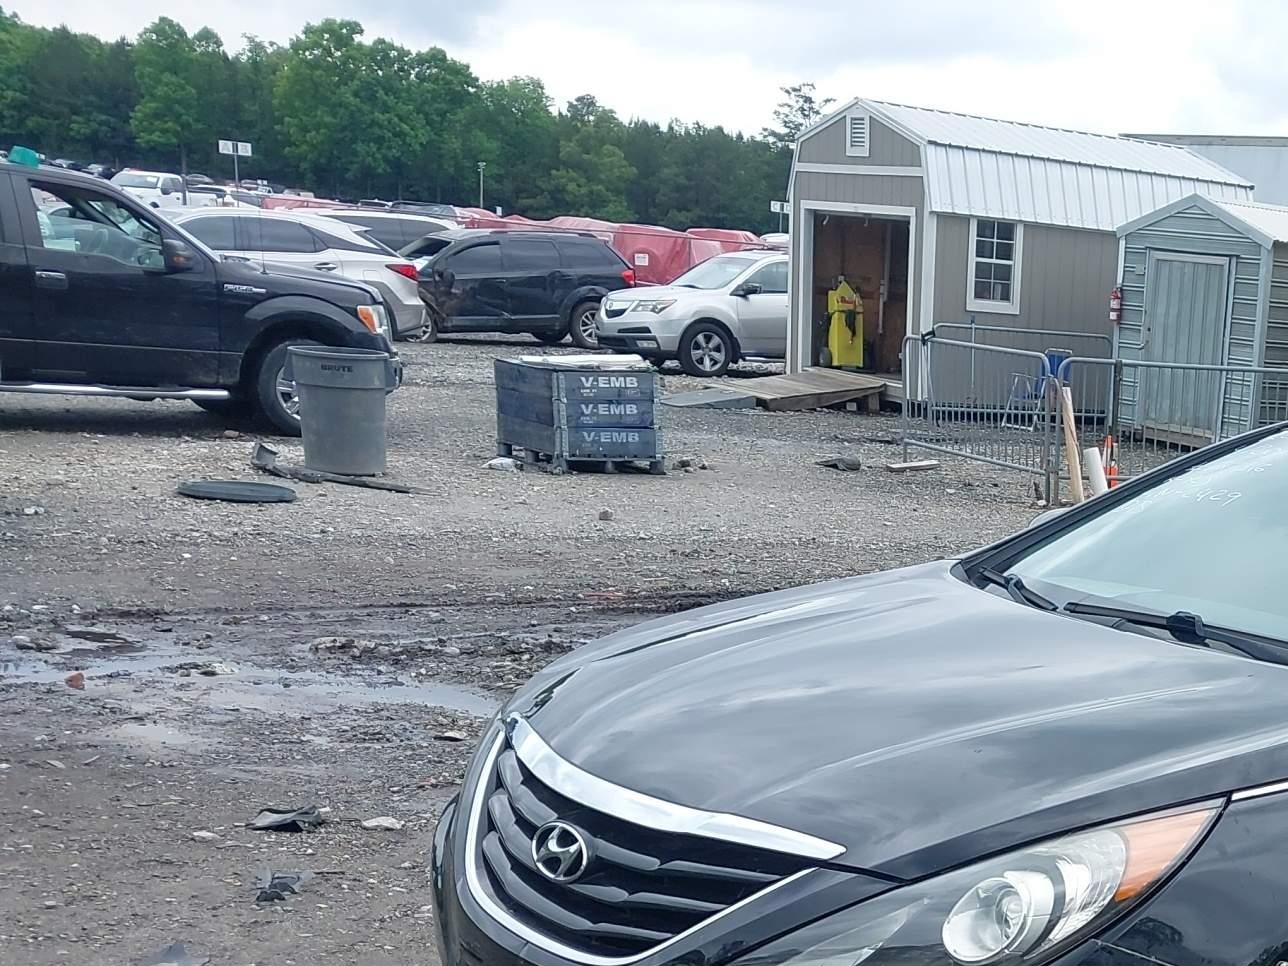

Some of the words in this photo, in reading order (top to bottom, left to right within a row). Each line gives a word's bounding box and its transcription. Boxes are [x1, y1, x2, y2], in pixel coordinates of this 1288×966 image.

[580, 376, 639, 388] V-EMB
[580, 404, 639, 415] V-EMB
[582, 431, 640, 443] V-EMB
